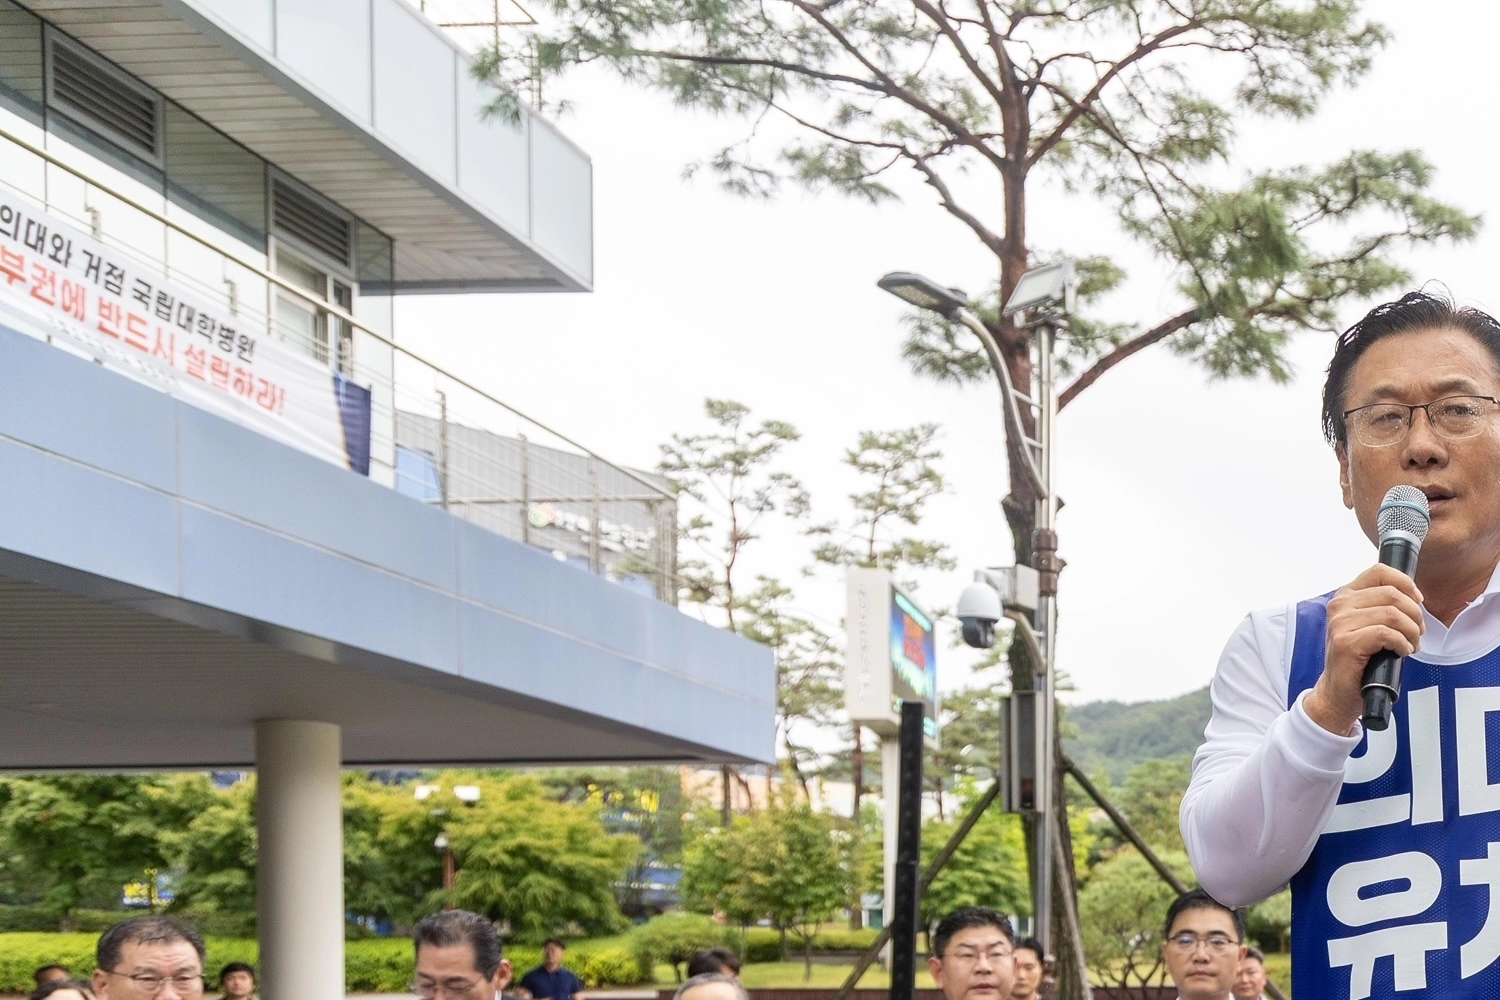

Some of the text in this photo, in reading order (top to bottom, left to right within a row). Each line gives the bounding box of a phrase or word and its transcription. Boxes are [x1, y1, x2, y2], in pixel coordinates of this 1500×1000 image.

[0, 205, 72, 268] 의대와
[82, 249, 125, 297] 거점
[132, 277, 256, 364] 국립대학병원
[0, 245, 87, 322] 부권에
[97, 297, 175, 366] 반드시
